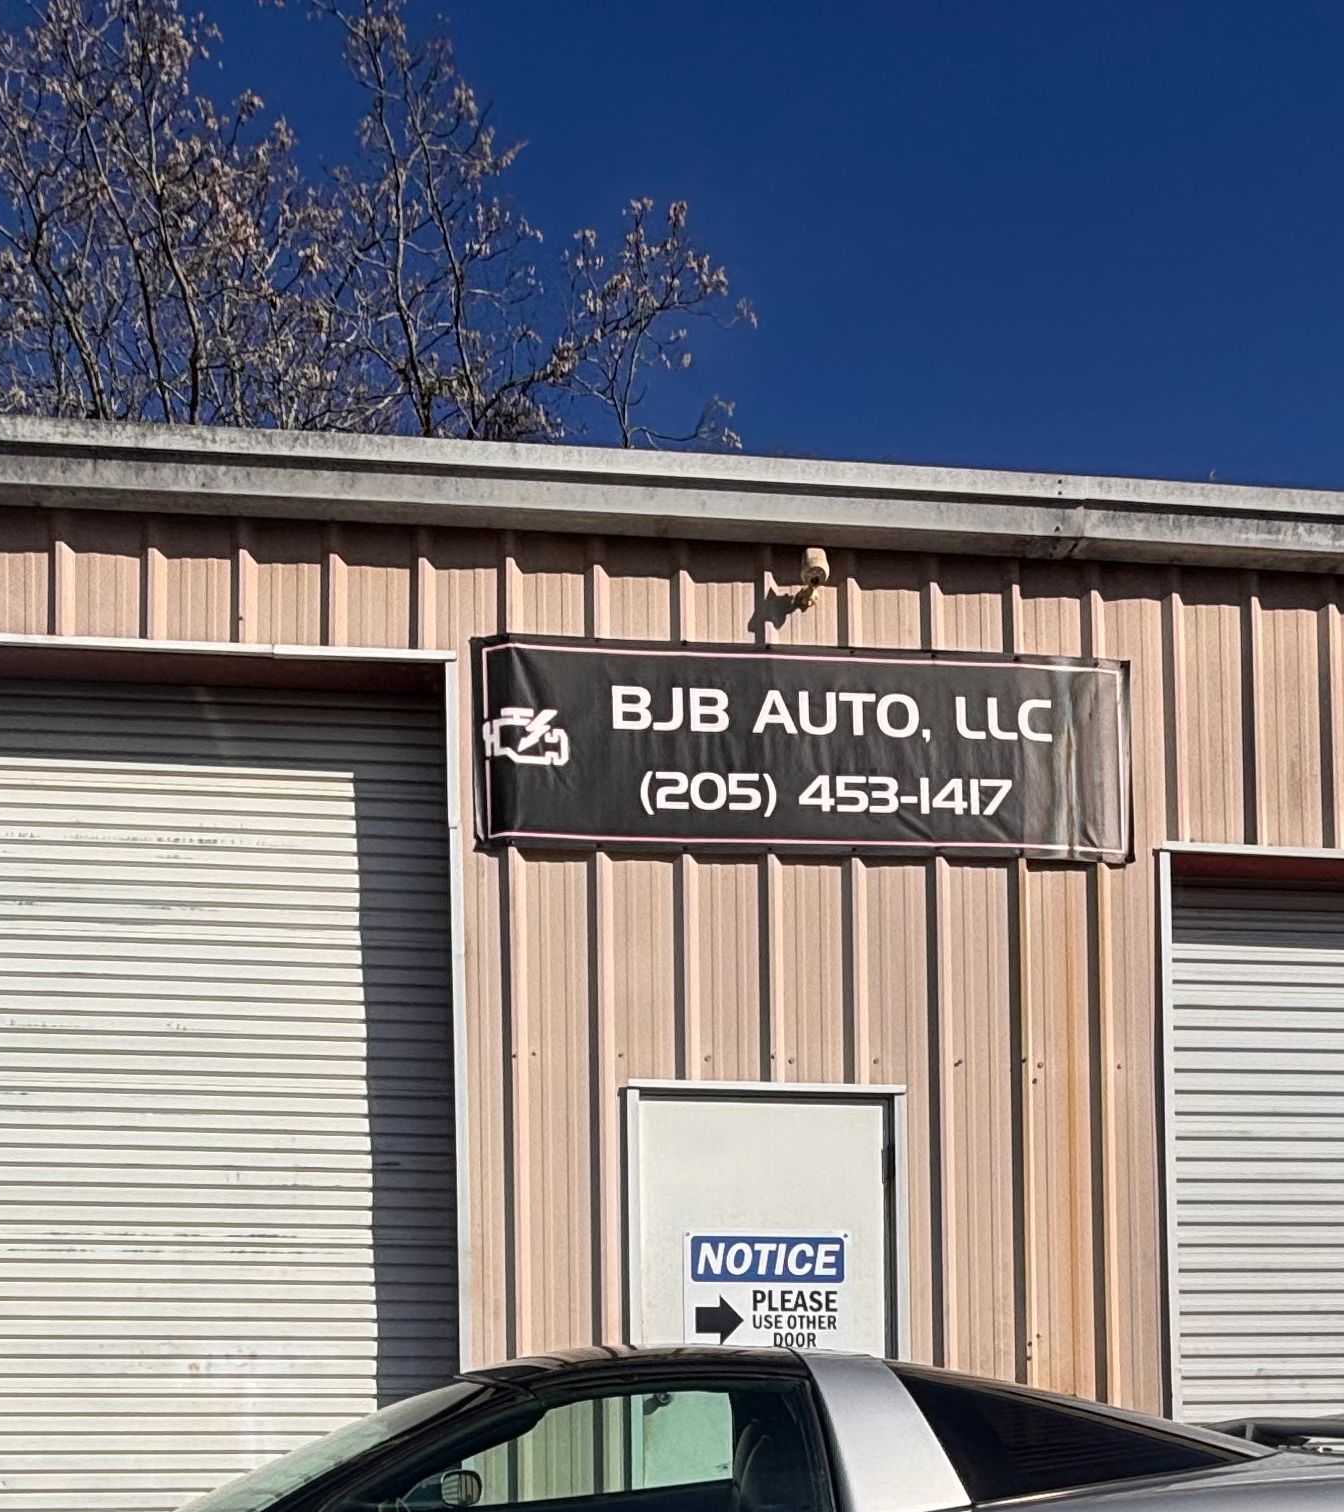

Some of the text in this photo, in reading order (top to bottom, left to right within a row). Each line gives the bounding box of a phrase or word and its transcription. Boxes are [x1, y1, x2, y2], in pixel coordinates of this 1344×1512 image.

[611, 684, 1053, 743] BJB AUTO, LLC
[640, 770, 1013, 818] (205) 453-1417
[696, 1242, 841, 1276] NOTICE
[752, 1289, 838, 1312] PLEASE
[752, 1314, 837, 1330] USE OTHER
[773, 1332, 817, 1347] DOOR
